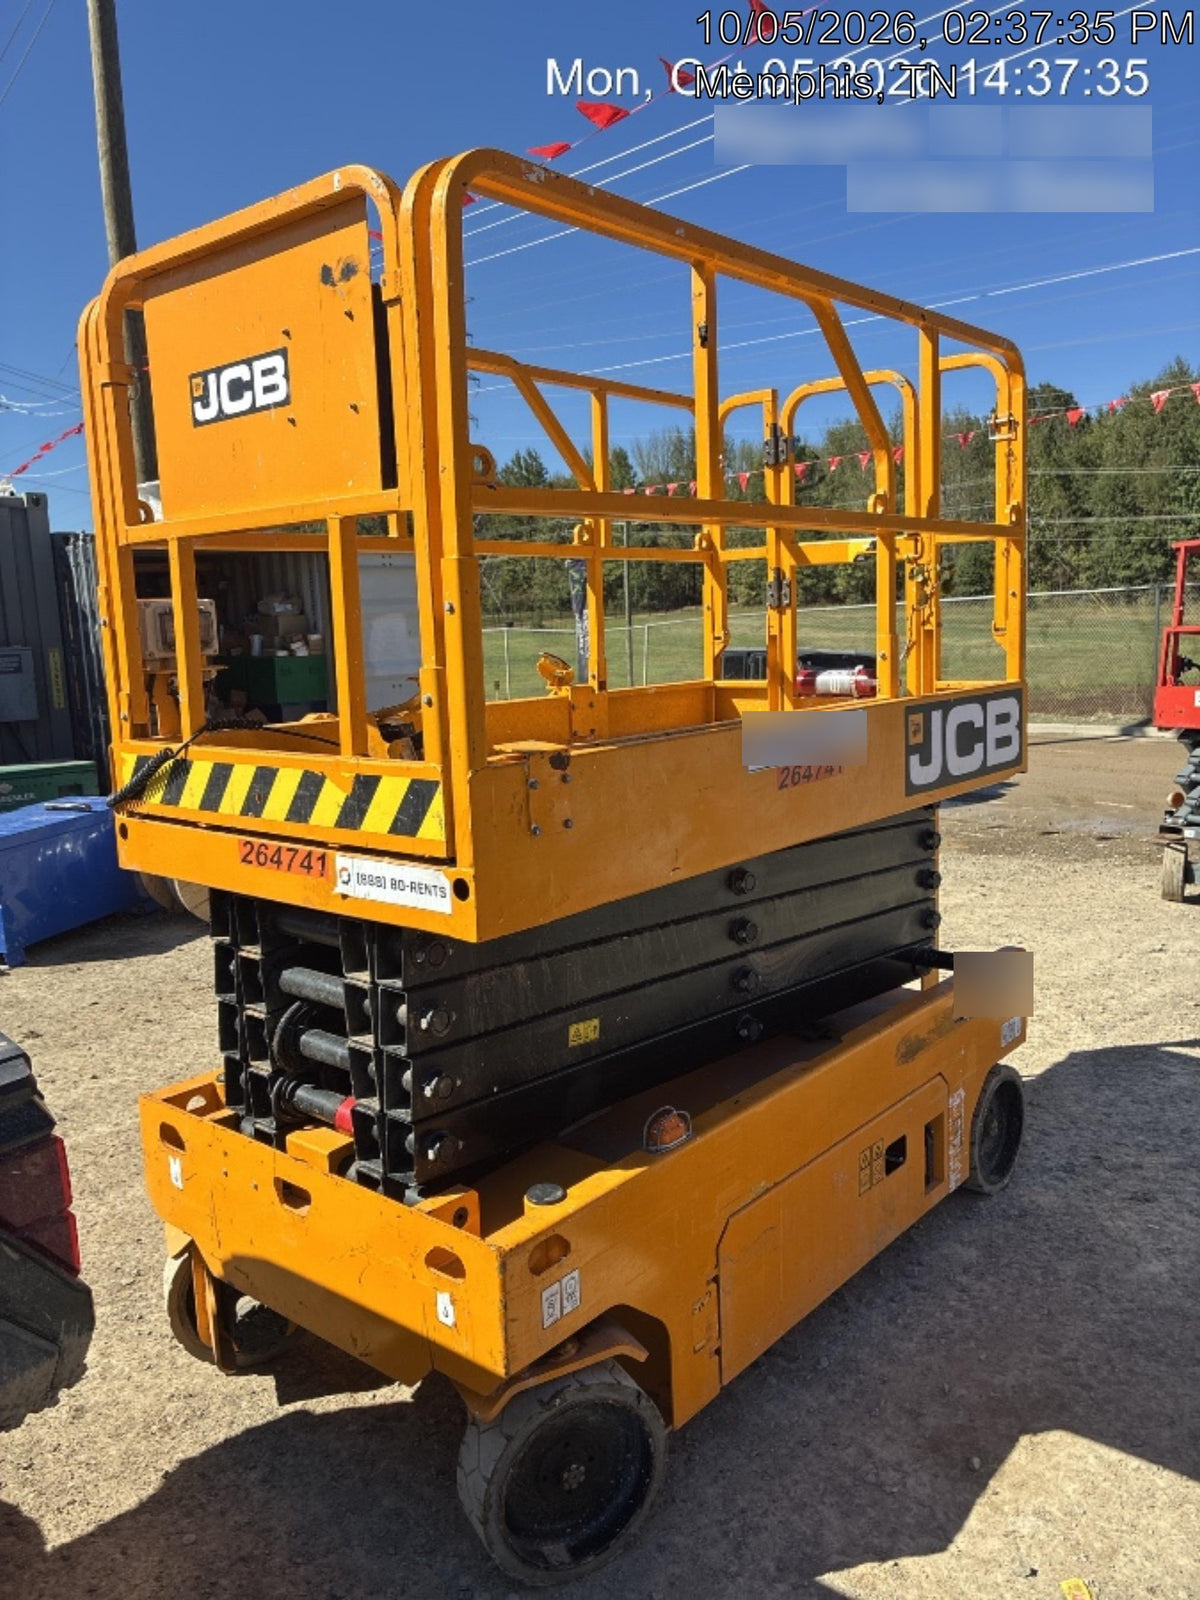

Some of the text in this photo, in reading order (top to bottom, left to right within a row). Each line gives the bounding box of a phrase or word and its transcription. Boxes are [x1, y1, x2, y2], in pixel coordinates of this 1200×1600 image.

[193, 354, 289, 422] JCB
[909, 697, 1021, 786] JCB
[240, 840, 328, 878] 264741
